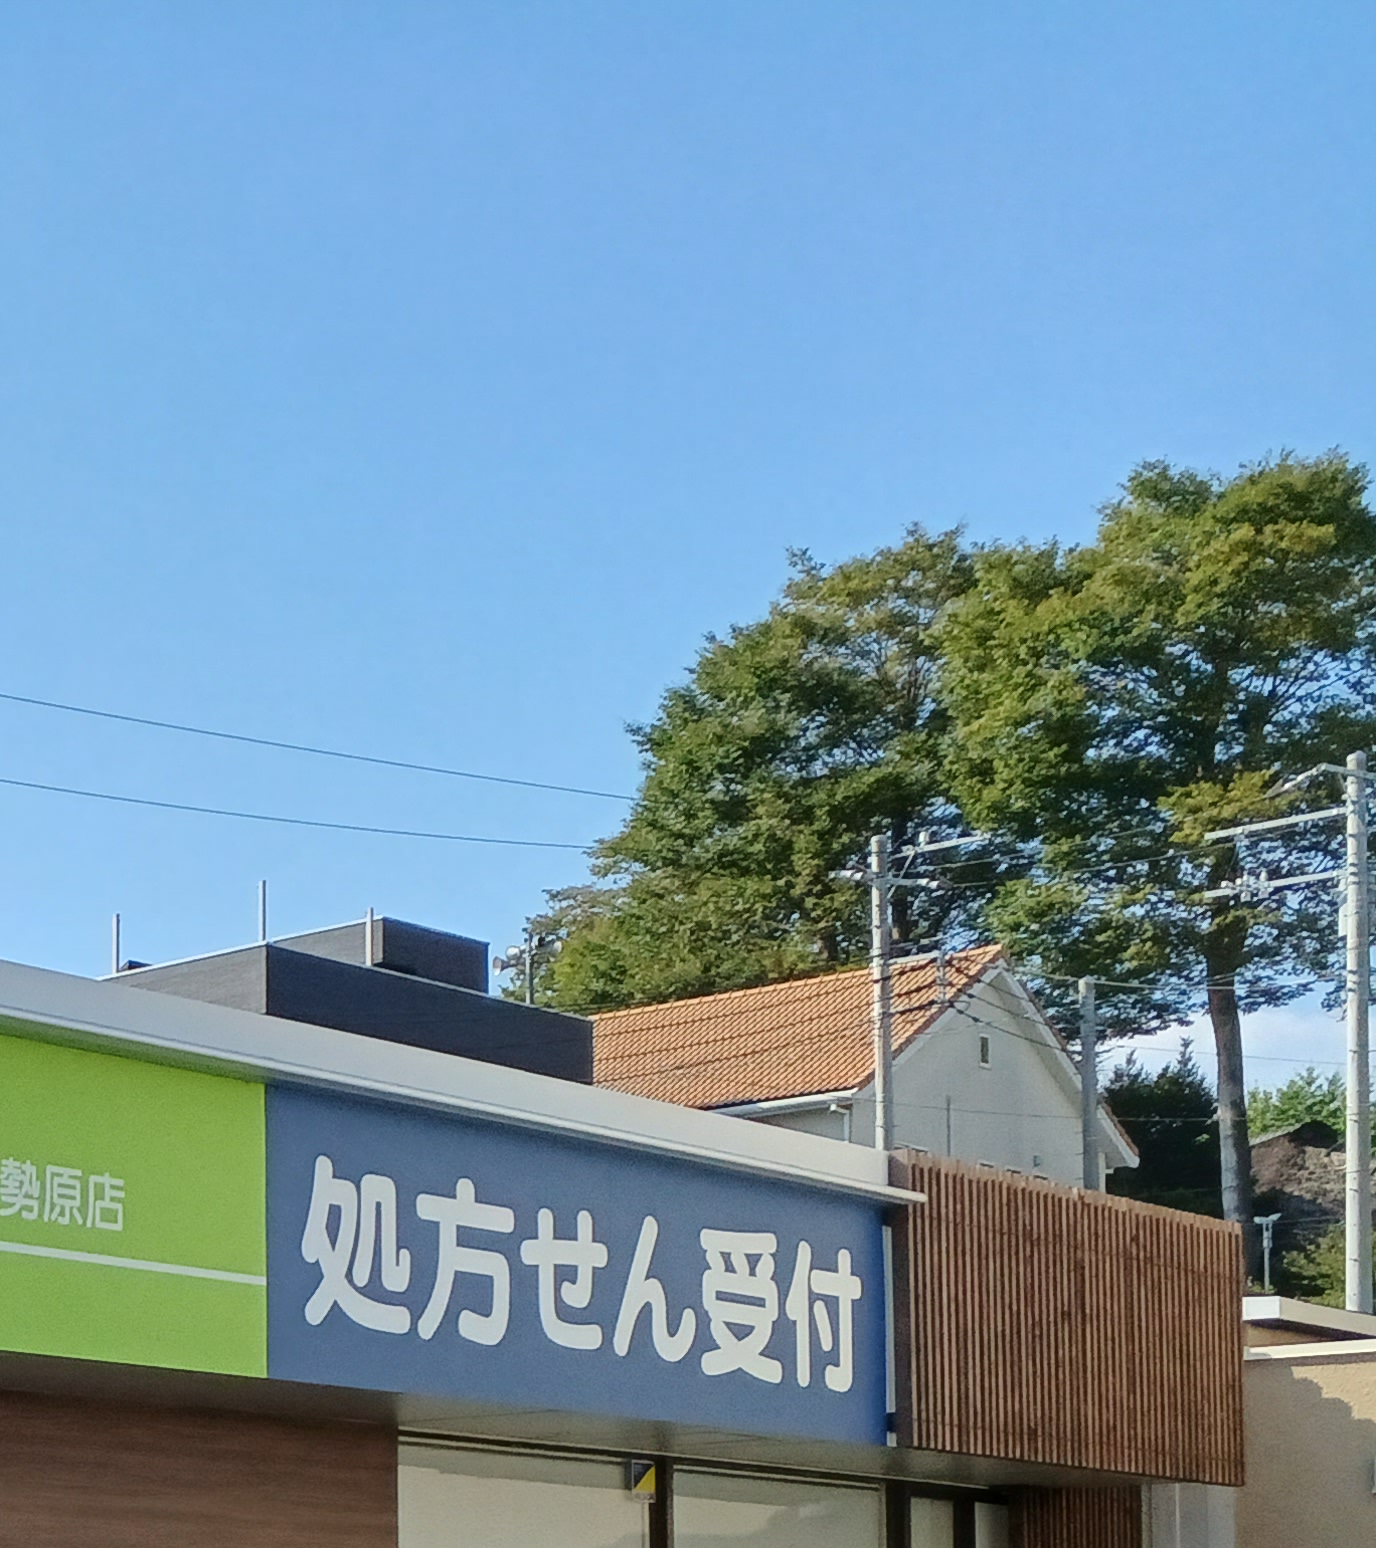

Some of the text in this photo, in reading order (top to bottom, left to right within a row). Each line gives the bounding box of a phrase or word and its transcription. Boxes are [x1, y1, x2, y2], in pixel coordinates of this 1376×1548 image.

[301, 1155, 862, 1392] 処方せん受付
